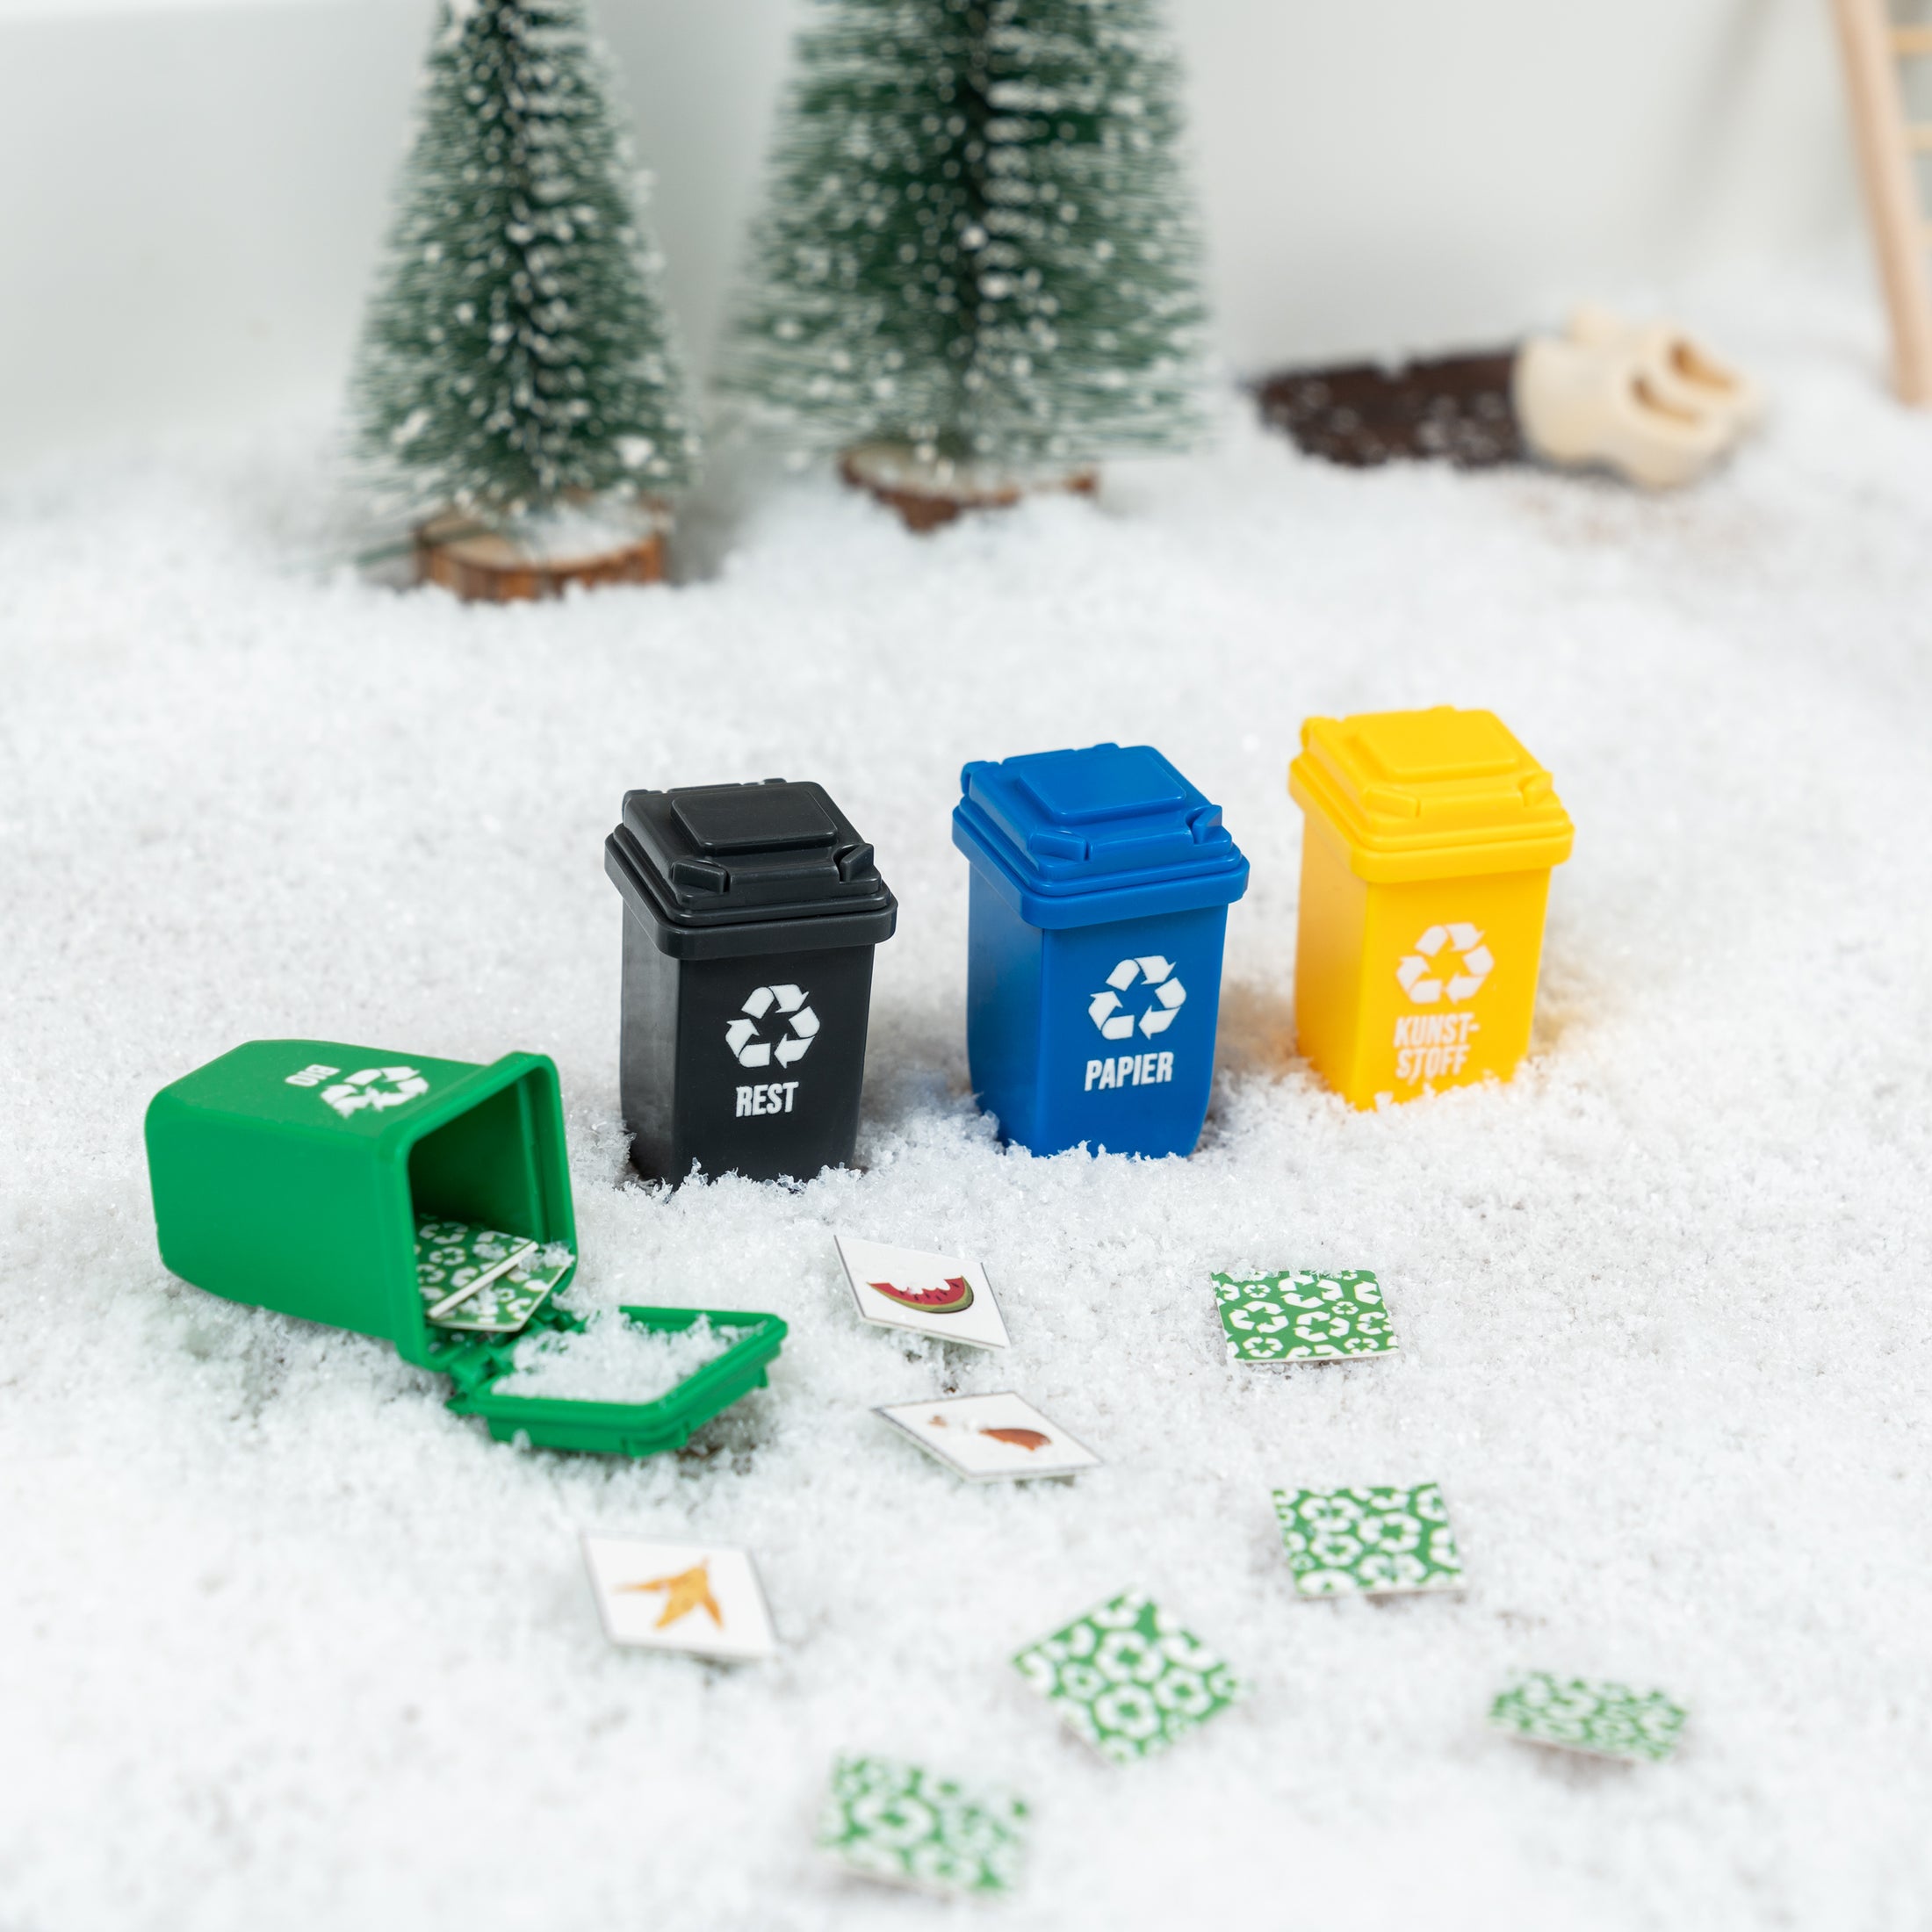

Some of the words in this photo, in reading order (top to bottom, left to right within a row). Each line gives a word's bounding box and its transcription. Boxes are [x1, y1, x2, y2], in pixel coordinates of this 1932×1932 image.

[1394, 1012, 1480, 1049] KUNST-
[285, 1063, 341, 1087] BIO
[1084, 1051, 1174, 1092] PAPIER
[1395, 1044, 1471, 1080] STOFF
[736, 1081, 799, 1117] REST
